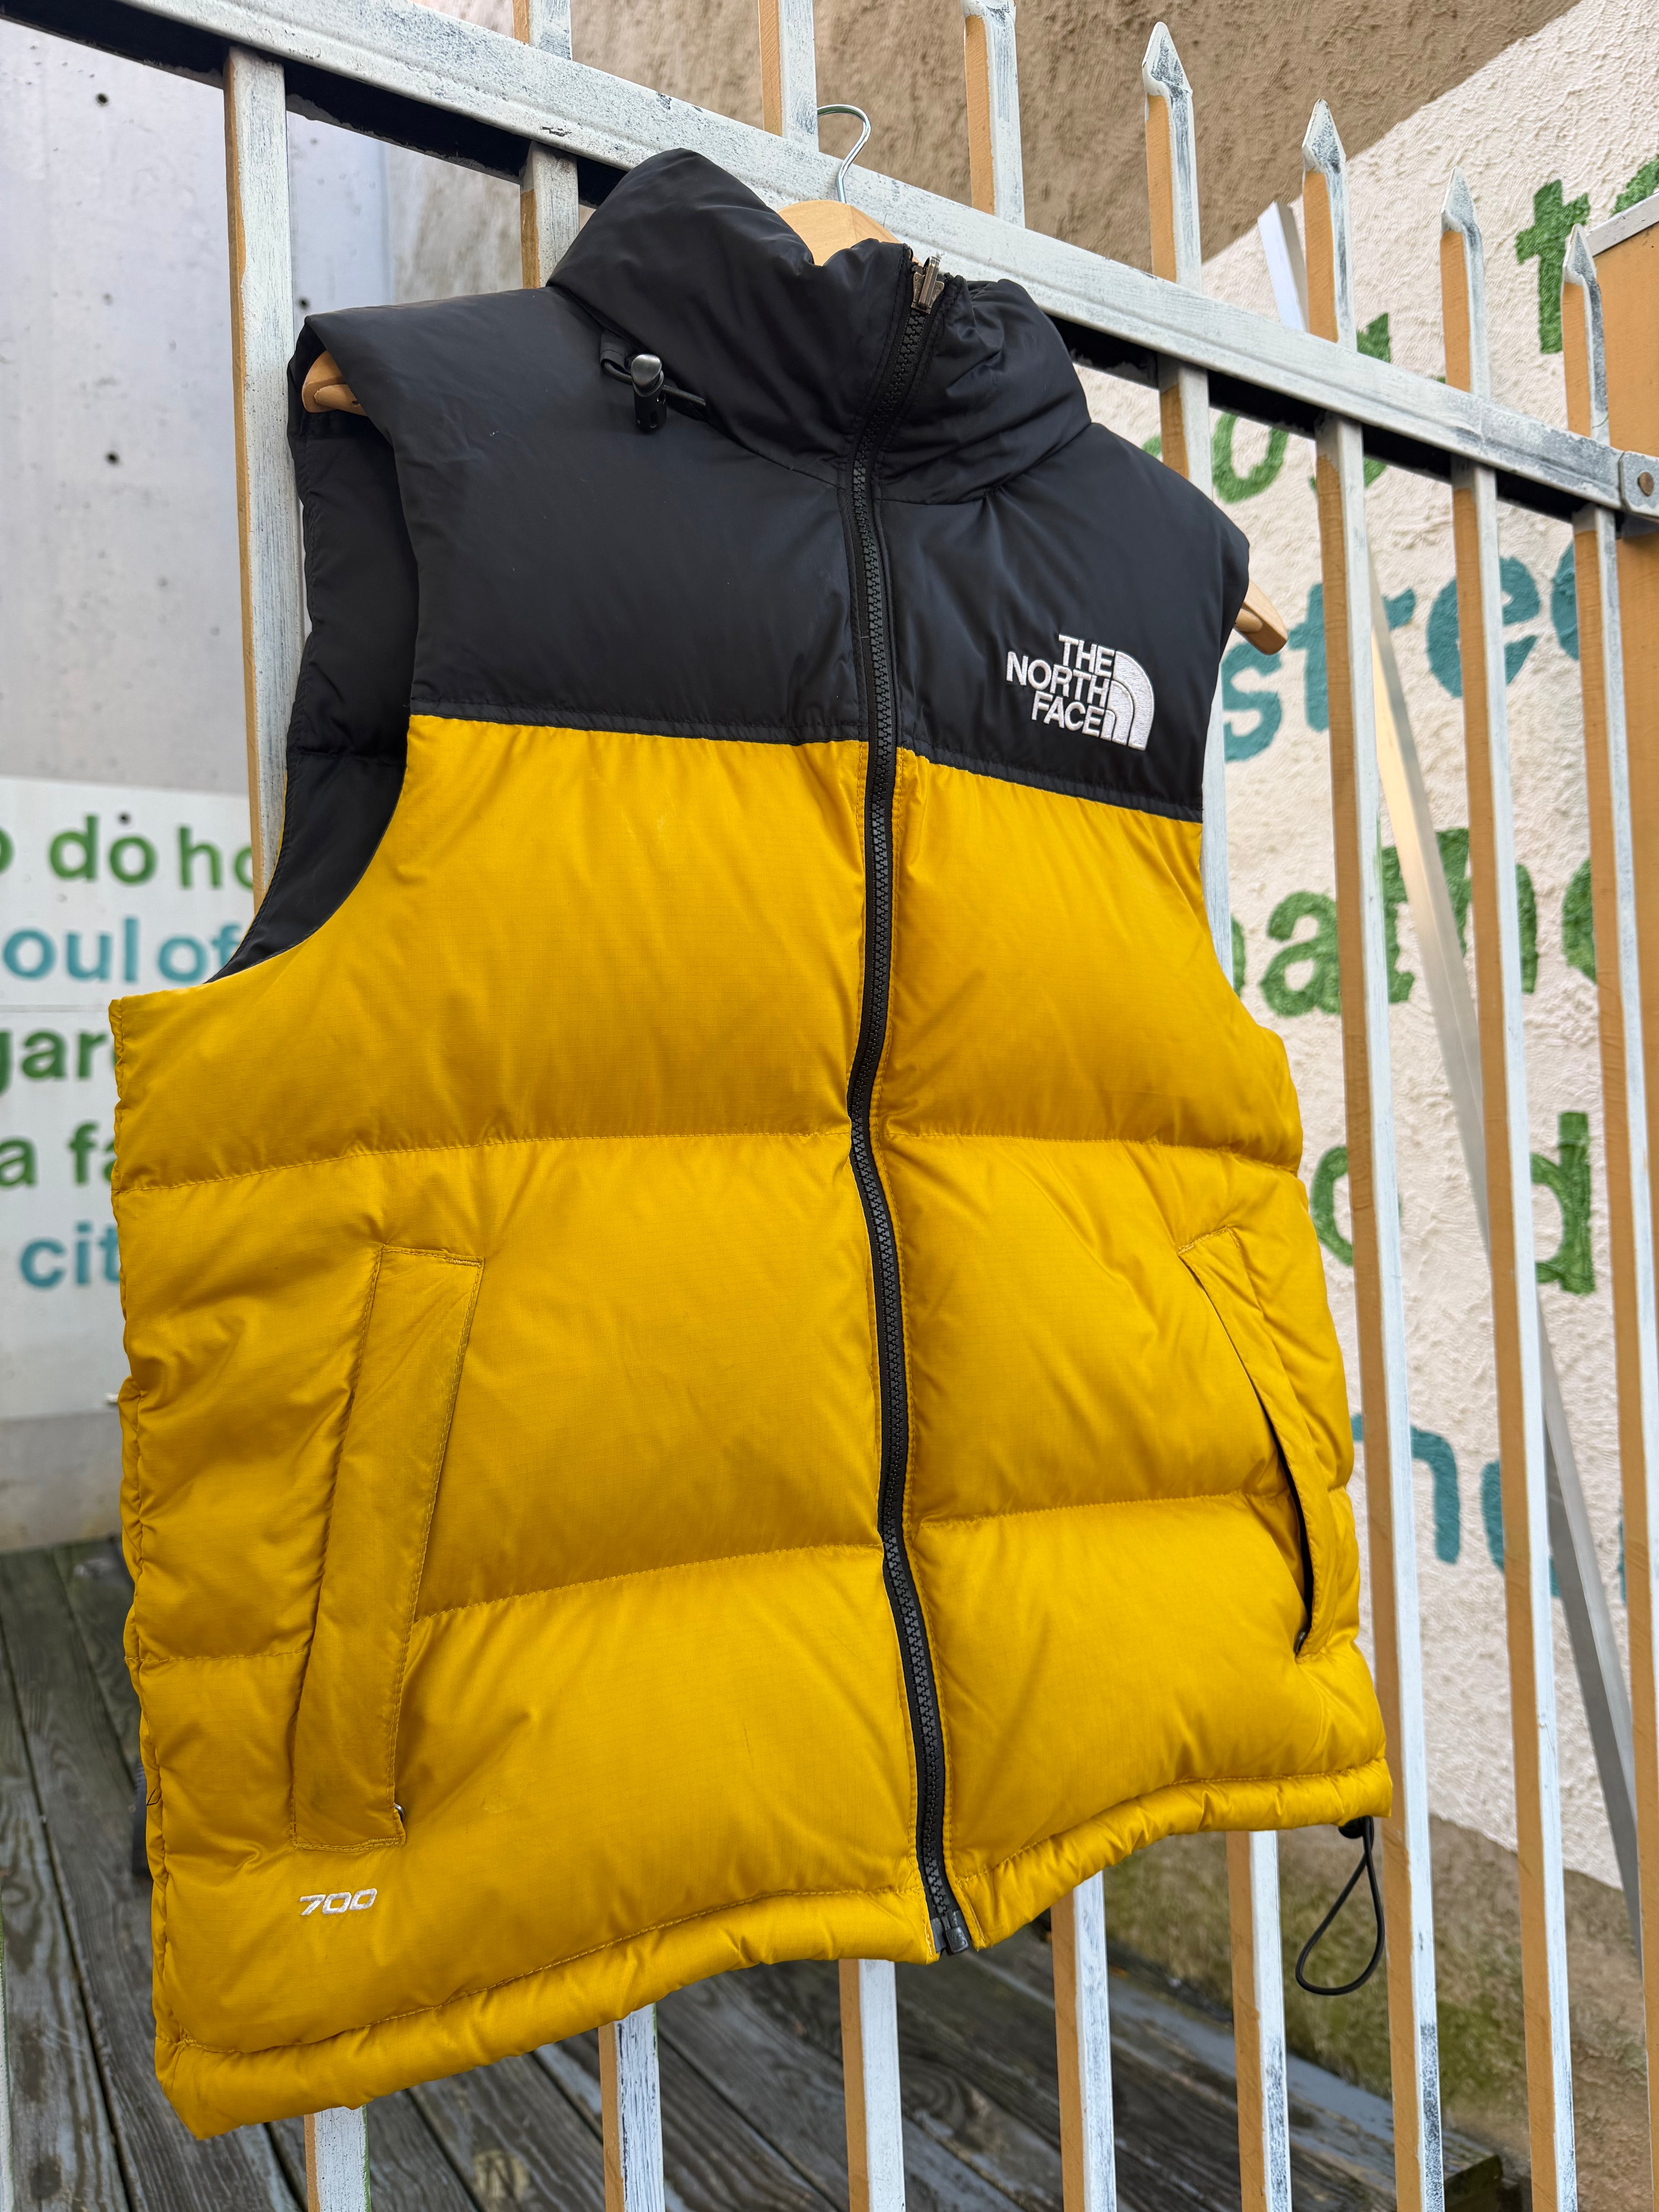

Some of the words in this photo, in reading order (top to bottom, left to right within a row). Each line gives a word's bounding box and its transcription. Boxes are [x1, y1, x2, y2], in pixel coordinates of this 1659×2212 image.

[1058, 634, 1115, 677] THE
[1006, 651, 1110, 708] NORTH
[1032, 690, 1104, 737] FACE
[48, 814, 156, 886] do
[299, 1888, 377, 1916] 700
